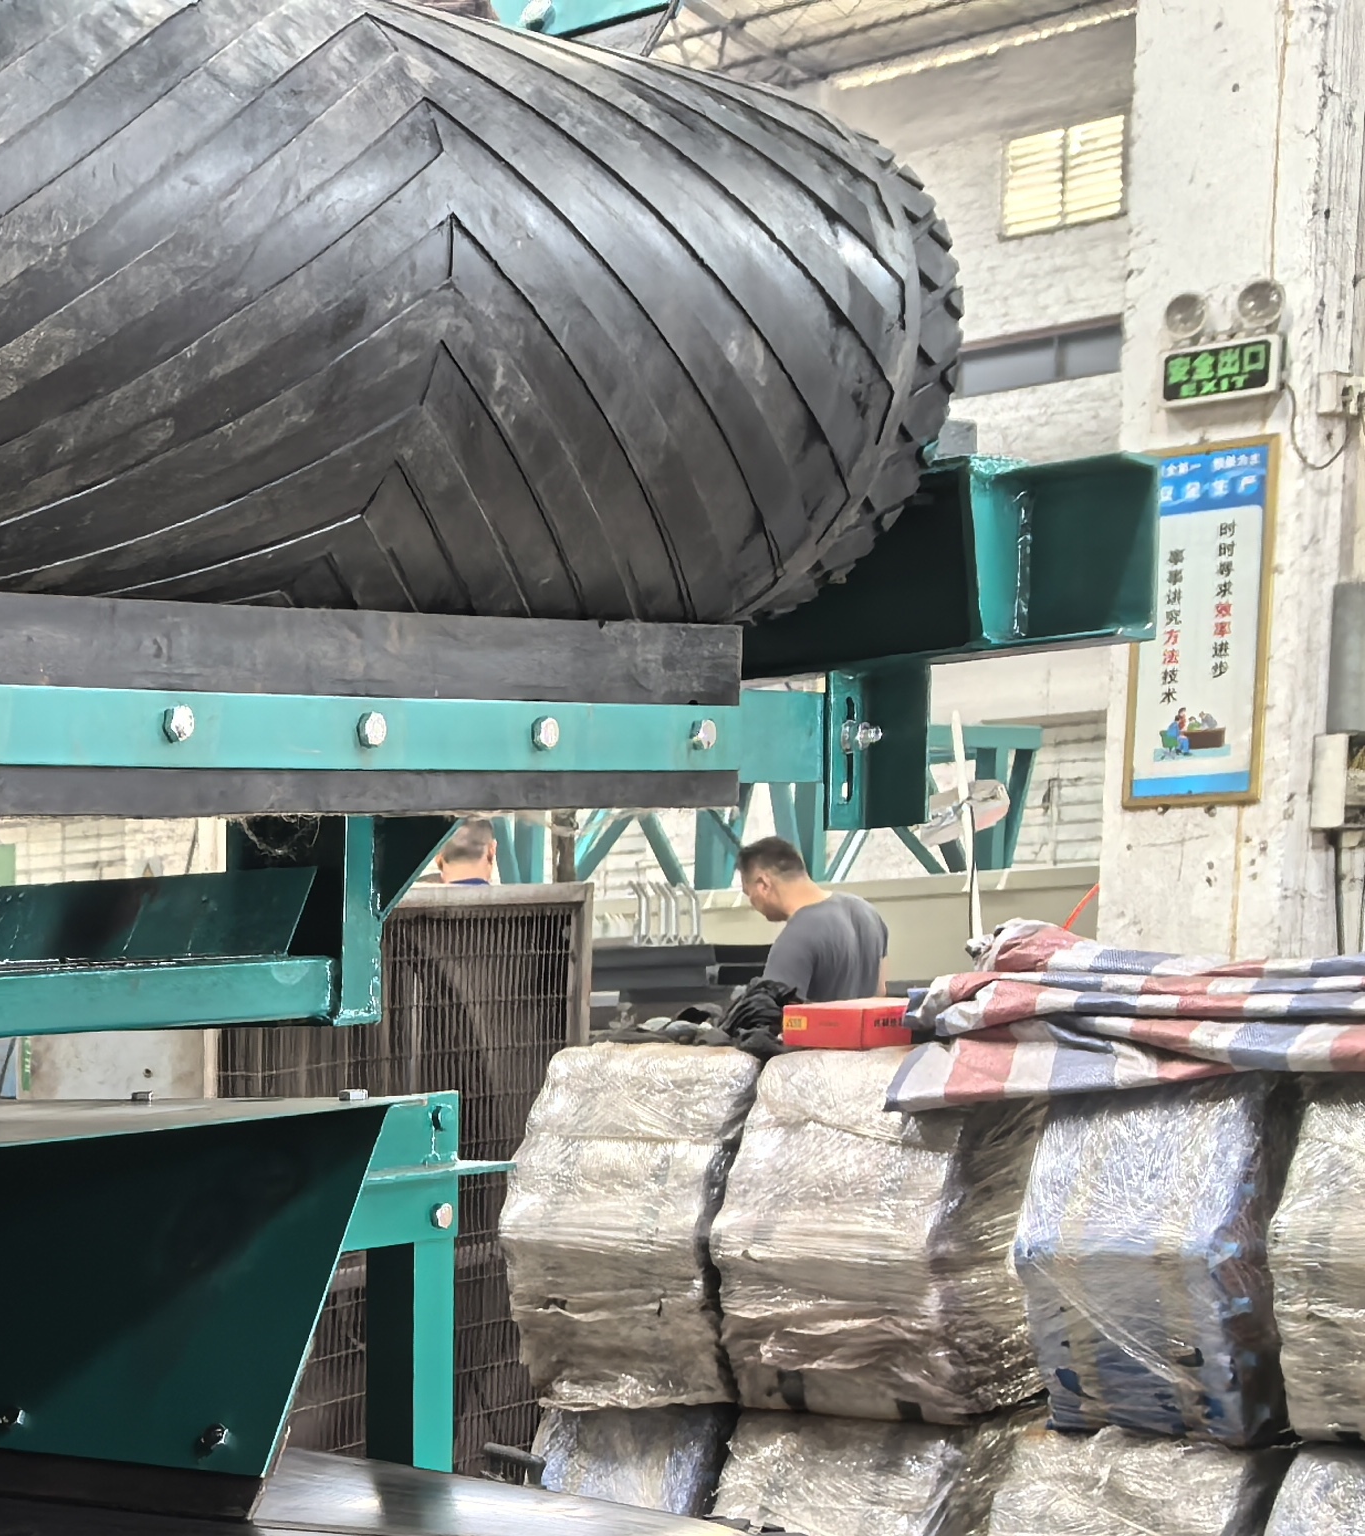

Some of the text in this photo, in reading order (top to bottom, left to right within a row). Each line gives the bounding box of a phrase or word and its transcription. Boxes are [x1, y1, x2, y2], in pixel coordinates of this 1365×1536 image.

[1167, 344, 1266, 386] 安全出口
[1180, 375, 1250, 397] EXIT
[1161, 461, 1202, 477] 全第一
[1211, 519, 1237, 679] 时时寻求效率进步
[1159, 548, 1186, 705] 事事讲究方法技术
